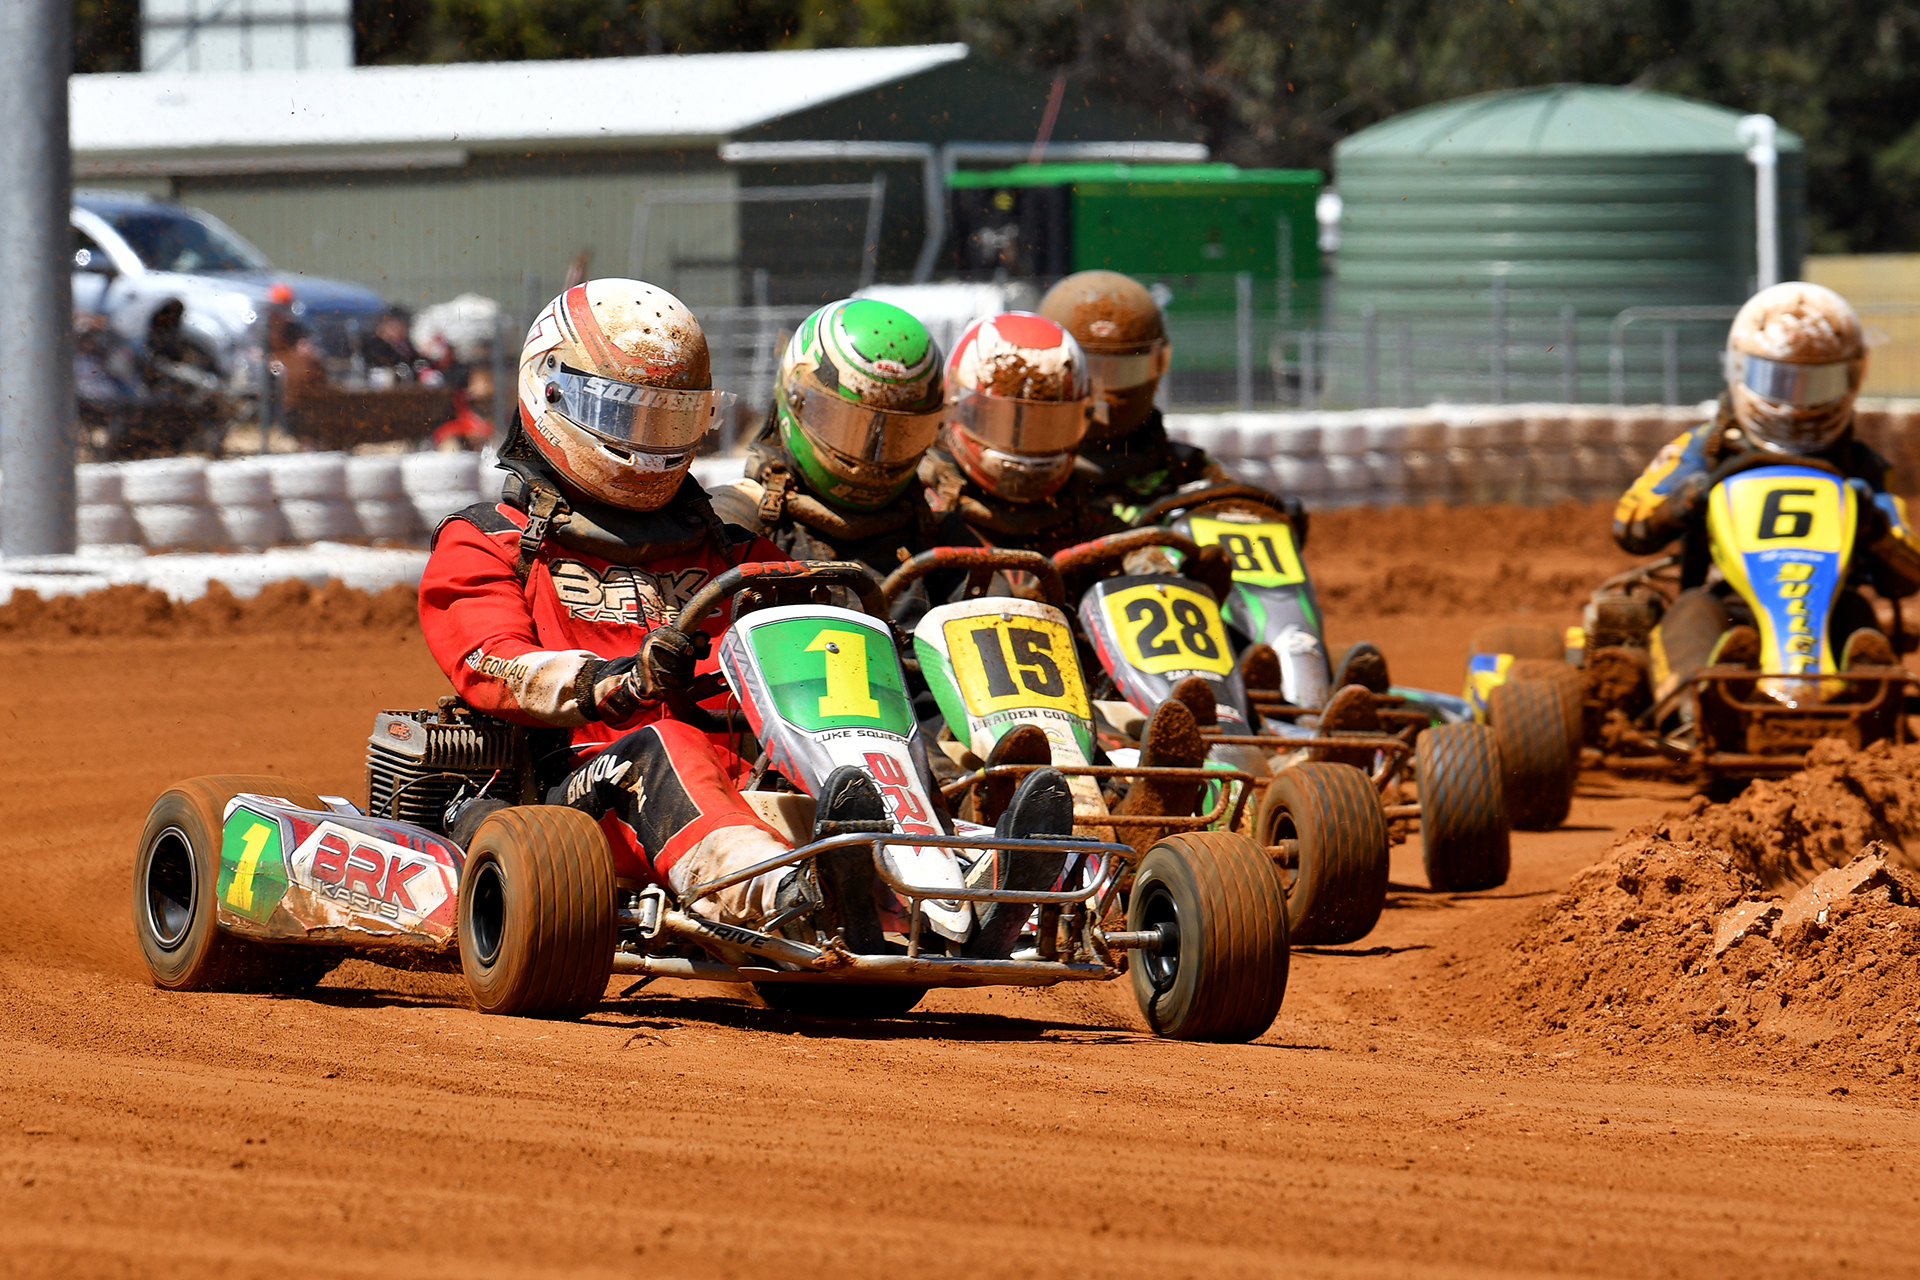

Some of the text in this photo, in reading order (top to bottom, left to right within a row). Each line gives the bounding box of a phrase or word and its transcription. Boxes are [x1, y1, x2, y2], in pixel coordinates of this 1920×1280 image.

[534, 416, 561, 447] LUKE
[1758, 489, 1816, 539] 6
[1218, 533, 1285, 574] 81
[548, 558, 709, 612] BRK
[1125, 598, 1219, 660] 28
[803, 628, 881, 718] 1
[971, 627, 1065, 698] 15
[814, 729, 910, 747] LUKE SQUIERS
[972, 709, 1038, 732] BRAIDEN
[861, 751, 950, 859] BRK
[225, 822, 273, 912] 1
[311, 832, 428, 913] BRK
[318, 881, 401, 919] KARTS
